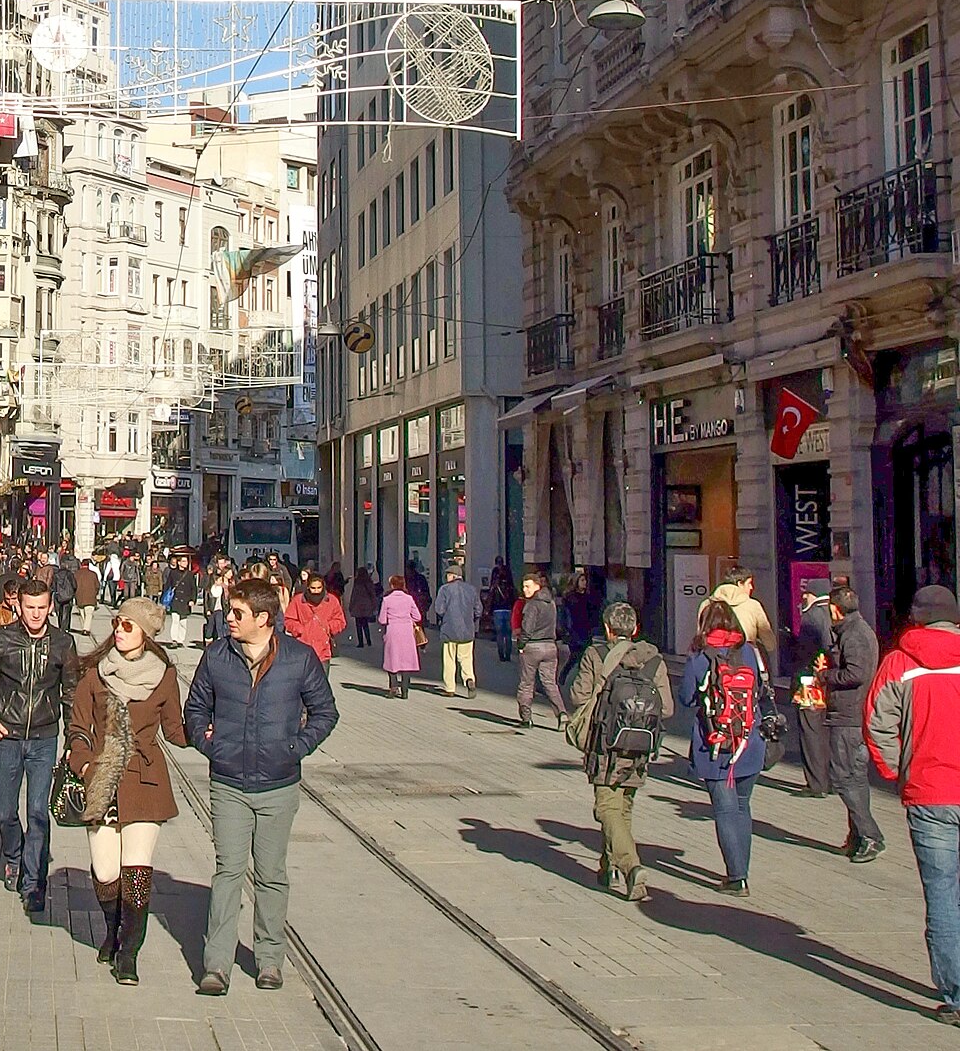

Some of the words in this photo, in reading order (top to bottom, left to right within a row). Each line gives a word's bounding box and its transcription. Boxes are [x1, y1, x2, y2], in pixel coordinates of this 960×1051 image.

[690, 424, 700, 441] BY
[700, 419, 728, 439] MANGO
[795, 484, 819, 554] WEST
